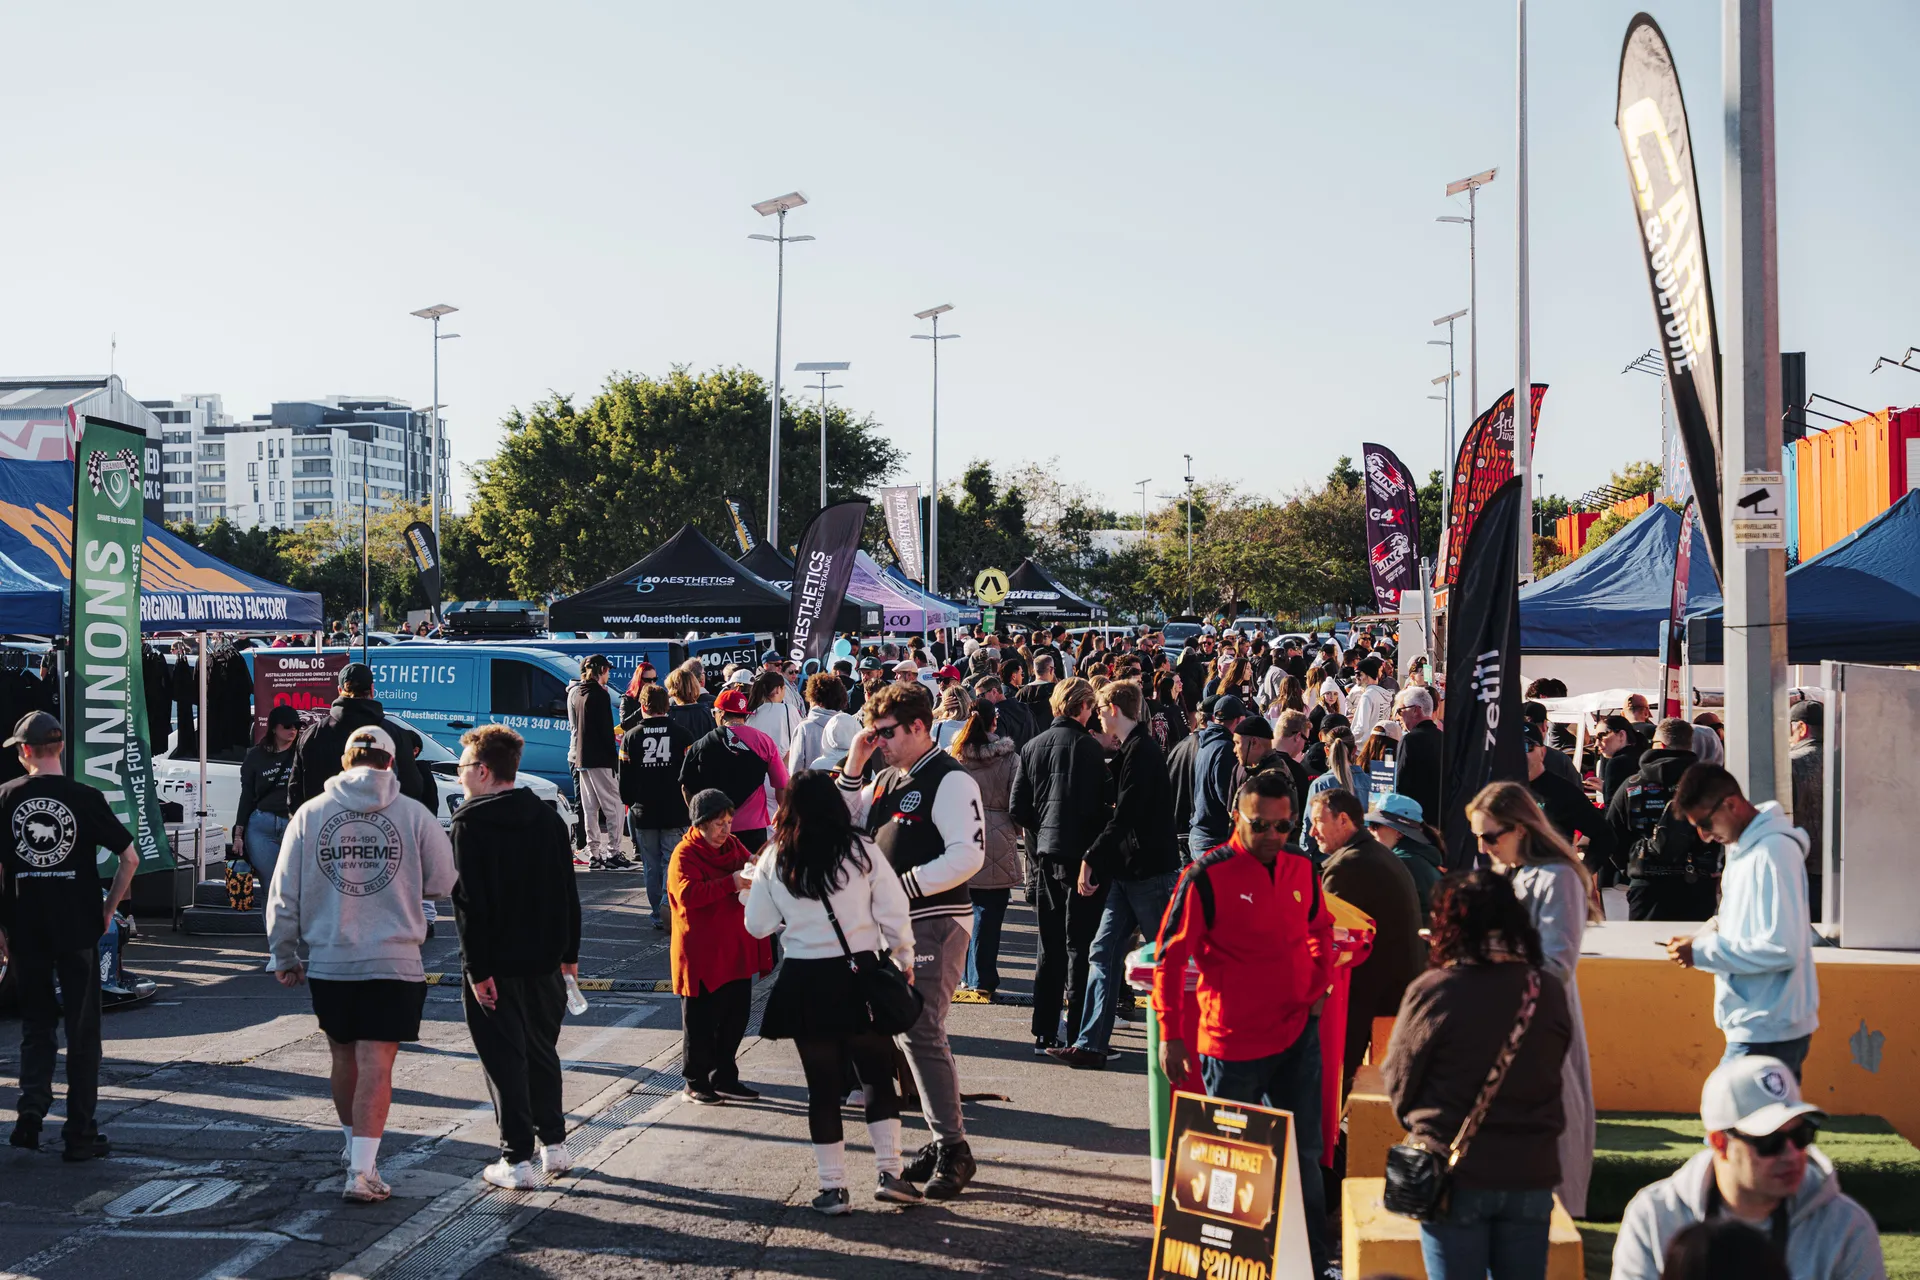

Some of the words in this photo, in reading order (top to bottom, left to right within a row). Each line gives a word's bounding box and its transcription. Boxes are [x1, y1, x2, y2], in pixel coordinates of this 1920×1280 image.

[1651, 244, 1699, 376] CULTURE
[1369, 507, 1405, 525] G4X
[813, 591, 824, 619] MOBILE
[819, 555, 833, 591] DETAILING
[140, 595, 185, 621] RIGINAL
[187, 595, 243, 620] MATTRESS
[244, 596, 288, 620] FACTORY
[603, 614, 741, 623] www.40aesthetics.com.au
[311, 658, 325, 669] 06
[370, 665, 456, 684] ESTHETICS
[502, 716, 528, 729] 0434
[531, 718, 551, 729] 340
[126, 741, 144, 772] FOR
[642, 736, 671, 763] 24
[15, 800, 72, 826] RINGERS
[137, 774, 160, 860] INSURANCE
[319, 811, 378, 846] ESTABLISHED
[379, 820, 399, 845] 1994
[16, 839, 72, 865] WESTERN
[319, 845, 399, 862] SUPREME
[338, 861, 356, 869] NEW
[357, 861, 380, 869] YORK
[363, 862, 396, 893] BELOVED
[1190, 1141, 1229, 1168] GOLDEN
[1229, 1148, 1264, 1174] TICKET
[1162, 1237, 1200, 1279] WIN
